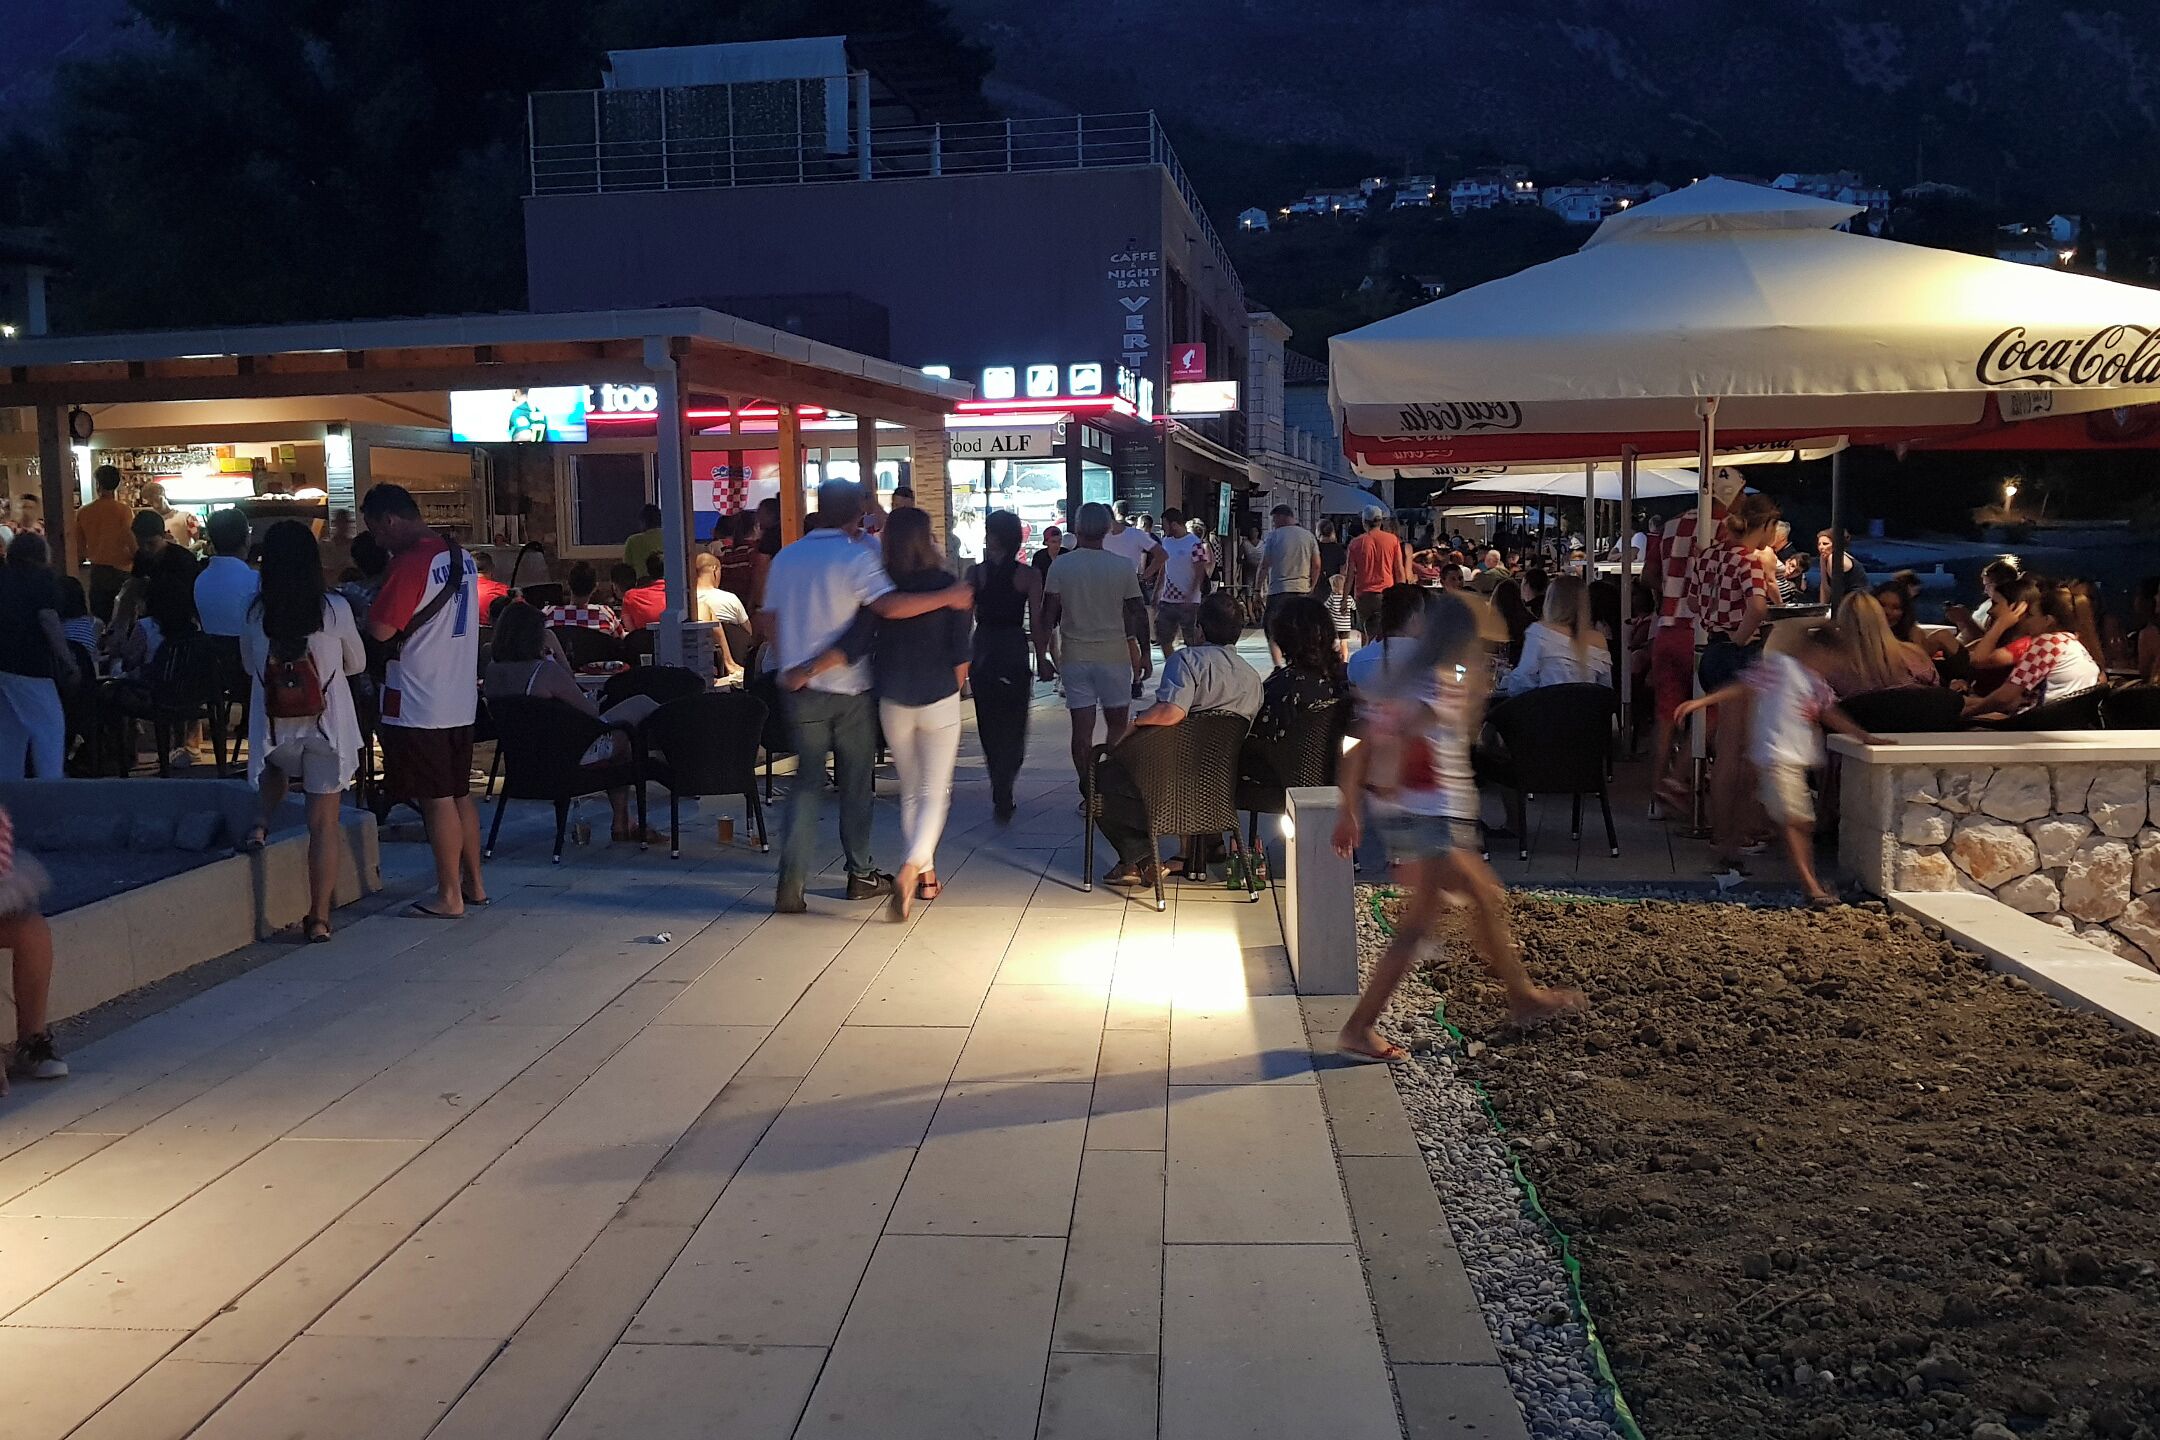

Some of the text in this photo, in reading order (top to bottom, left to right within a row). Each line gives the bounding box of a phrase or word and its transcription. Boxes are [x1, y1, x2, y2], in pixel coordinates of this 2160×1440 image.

[1110, 251, 1157, 263] CAFFE
[1108, 268, 1160, 279] NIGHT
[1117, 278, 1151, 289] BAR
[950, 435, 1032, 453] ood ALF
